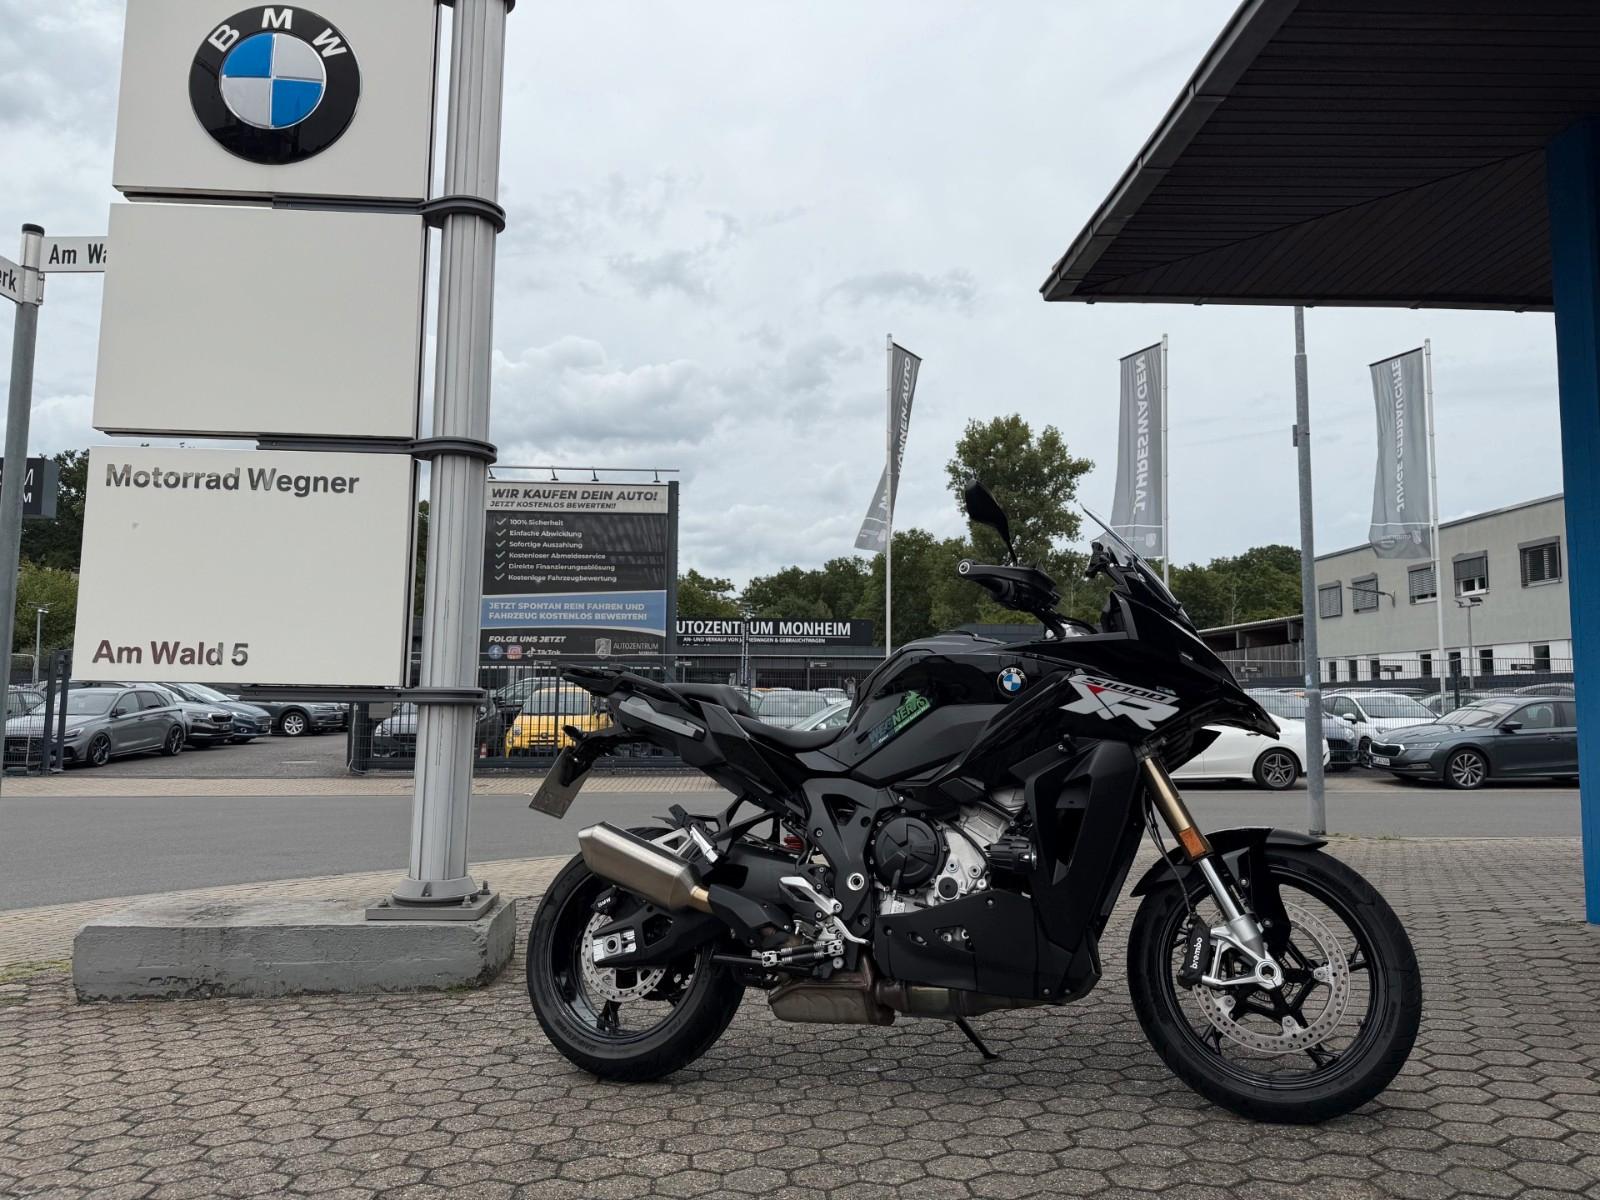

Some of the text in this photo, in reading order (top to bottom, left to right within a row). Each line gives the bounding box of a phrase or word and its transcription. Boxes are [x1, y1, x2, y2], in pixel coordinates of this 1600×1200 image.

[208, 8, 347, 57] BMW
[48, 244, 77, 264] Am
[105, 463, 360, 498] Motorrad Wegner
[492, 488, 658, 501] WIR KAUFEN DEIN AUTO!
[516, 501, 565, 509] KOSTENLOS
[528, 519, 564, 527] Sicherheit
[541, 530, 582, 538] Abwicklung
[509, 541, 541, 549] Sofortige
[488, 602, 515, 610] JETZT
[517, 602, 562, 610] SPONTAN
[564, 602, 585, 610] REIN
[587, 602, 624, 610] FAHREN
[488, 612, 539, 620] FAHRZEUG
[539, 612, 592, 620] KOSTENLOS
[676, 620, 851, 636] UTOZENTUM MONHEIM
[488, 635, 567, 643] FOLGE UNS JETZT
[92, 639, 249, 666] Am Wald 5
[1082, 676, 1168, 701] S1000
[1189, 937, 1203, 970] brembo
